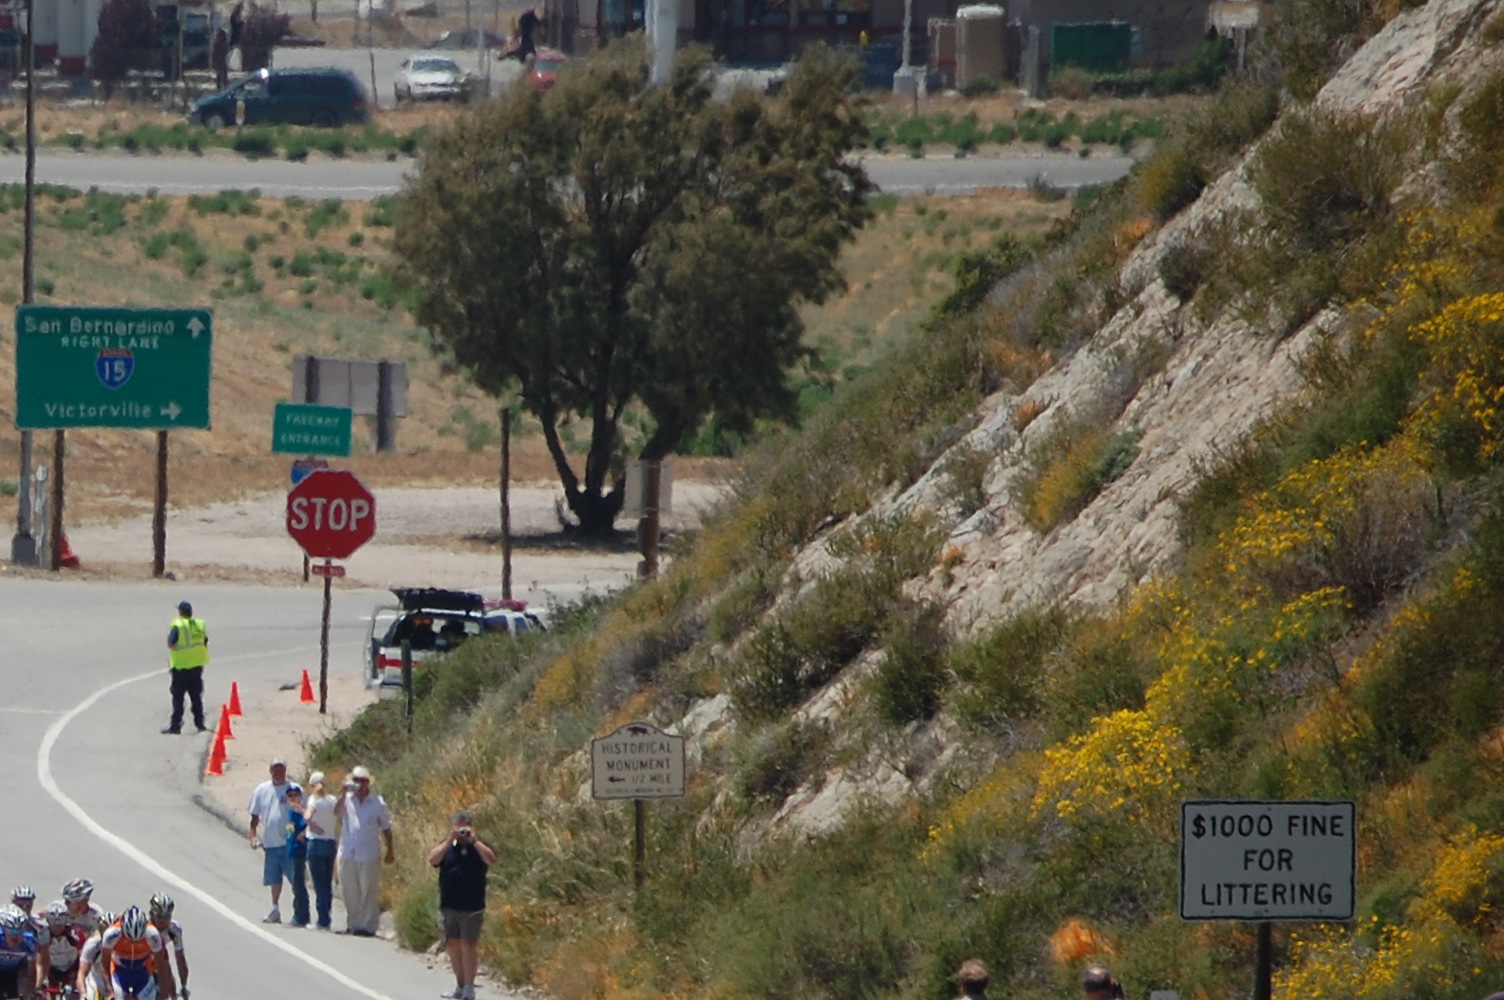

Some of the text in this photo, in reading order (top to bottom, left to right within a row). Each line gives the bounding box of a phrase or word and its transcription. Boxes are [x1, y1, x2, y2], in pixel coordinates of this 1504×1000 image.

[25, 315, 175, 336] San Bernardino
[61, 336, 160, 349] RIGHT LANE
[104, 360, 126, 382] 15
[45, 402, 152, 418] Victorville
[291, 497, 370, 531] STOP
[601, 741, 672, 755] HISTORICAL
[606, 758, 670, 771] MONUMENT
[650, 773, 671, 784] MILE
[1192, 813, 1344, 838] $1000 FINE
[1243, 848, 1294, 872] FOR
[1201, 883, 1333, 906] LITTERING
